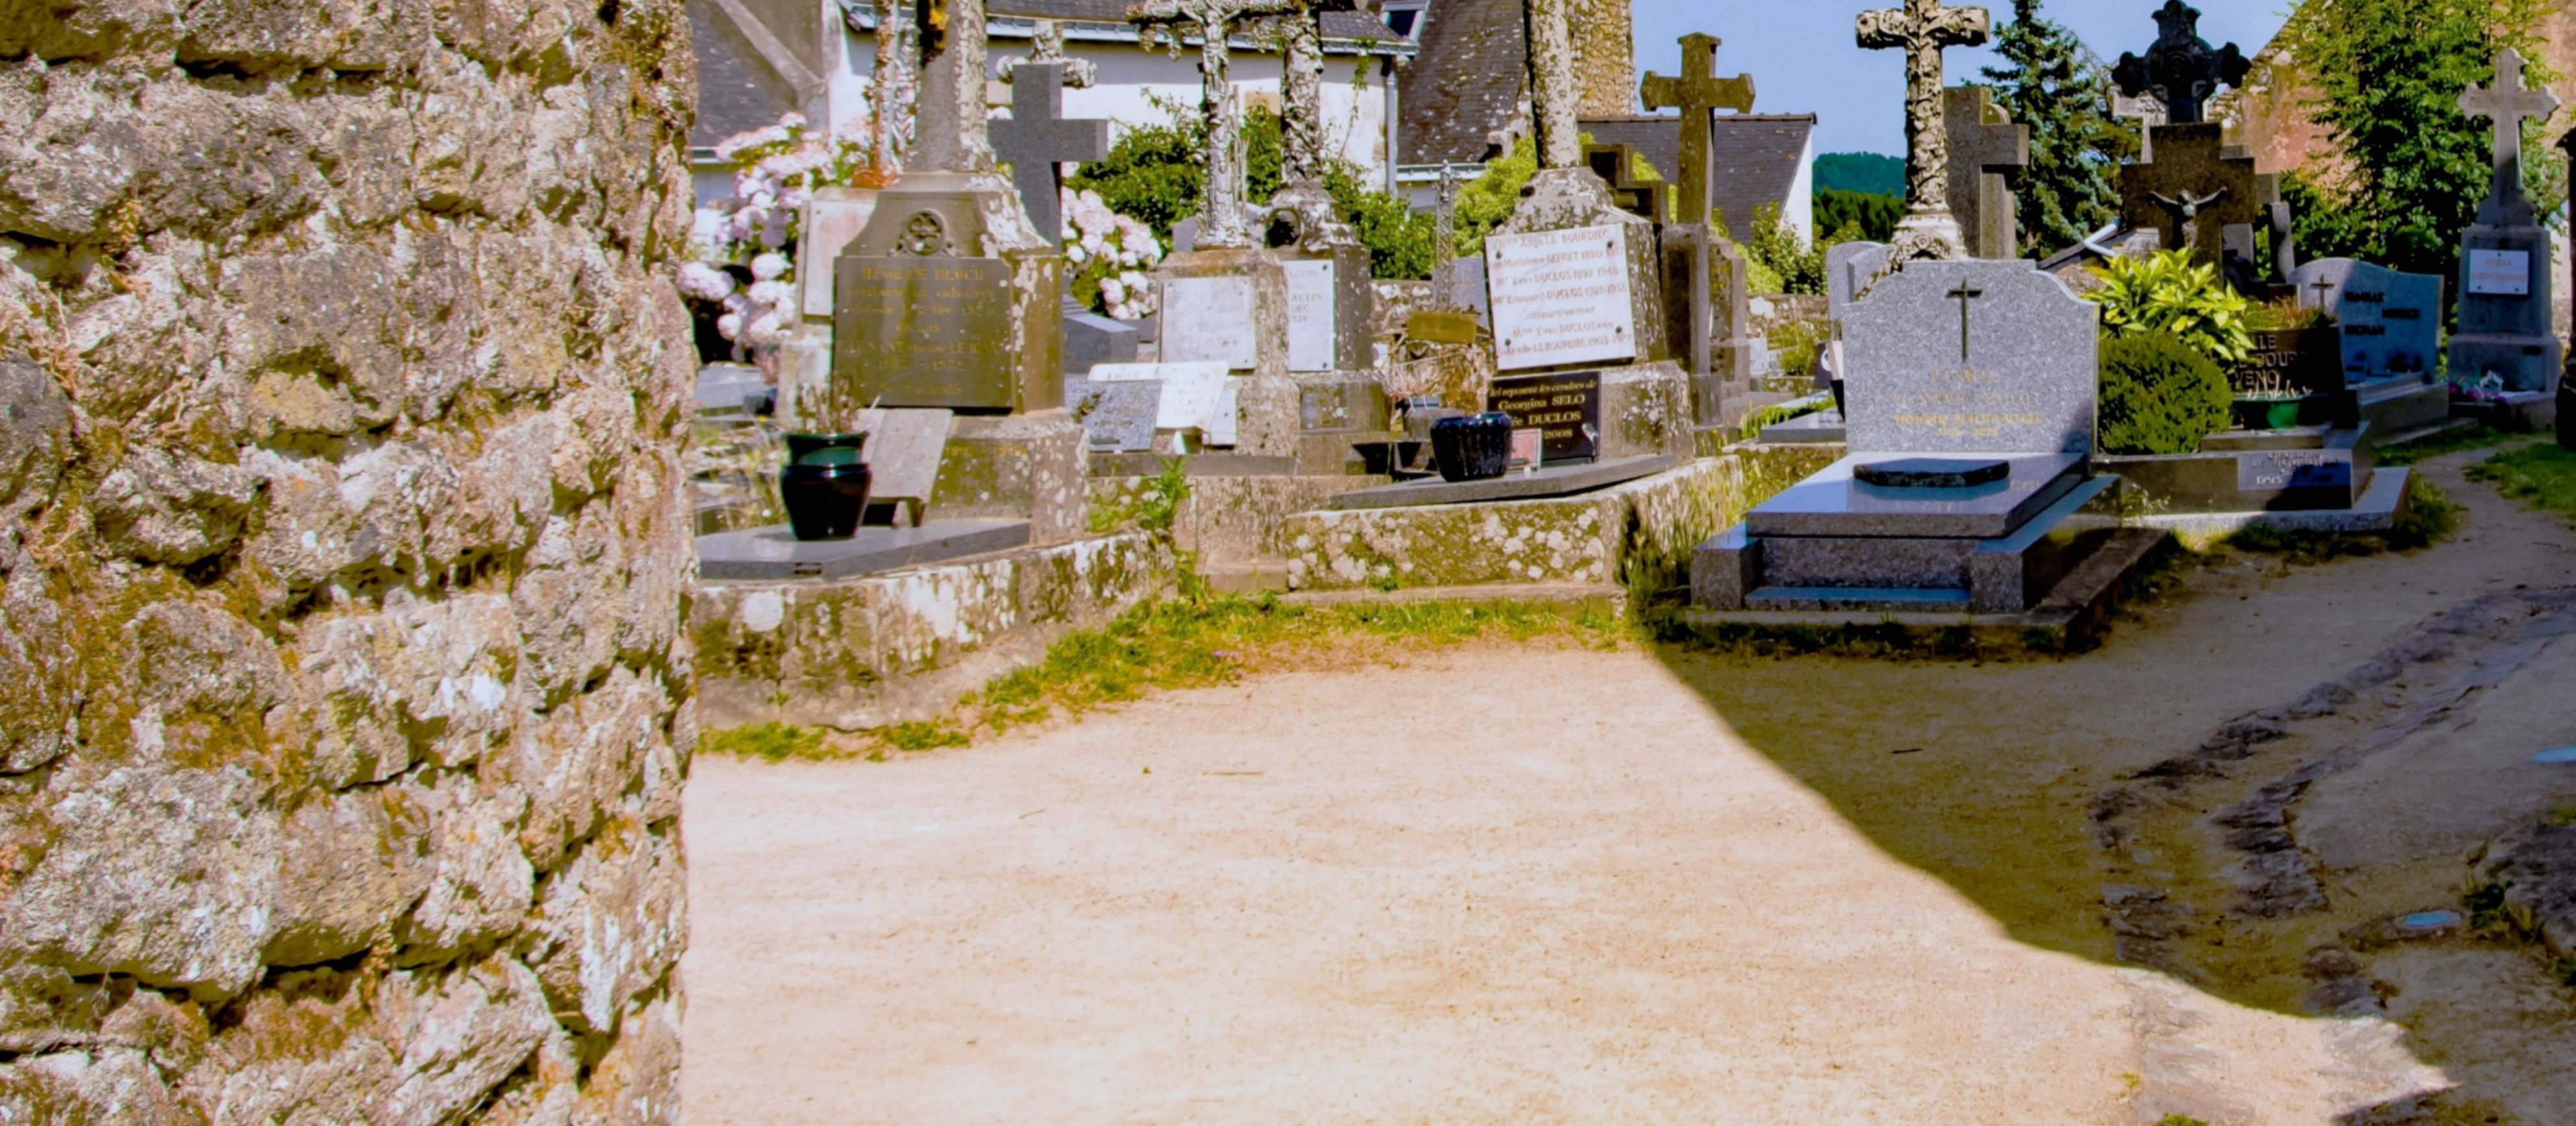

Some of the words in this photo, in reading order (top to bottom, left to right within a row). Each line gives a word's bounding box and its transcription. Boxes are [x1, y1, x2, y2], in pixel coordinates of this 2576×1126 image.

[1546, 235, 1557, 245] LE
[1562, 230, 1609, 244] BOURDIEC
[1535, 270, 1572, 283] DUCLOS
[1546, 287, 1584, 300] DUCLOS
[1559, 322, 1596, 333] DUCLOS
[1539, 383, 1551, 393] les
[1551, 380, 1585, 392] cendres
[1585, 379, 1597, 389] de
[1498, 398, 1547, 411] Georgina
[1551, 393, 1586, 407] SELO
[1528, 411, 1581, 425] DUCLOS
